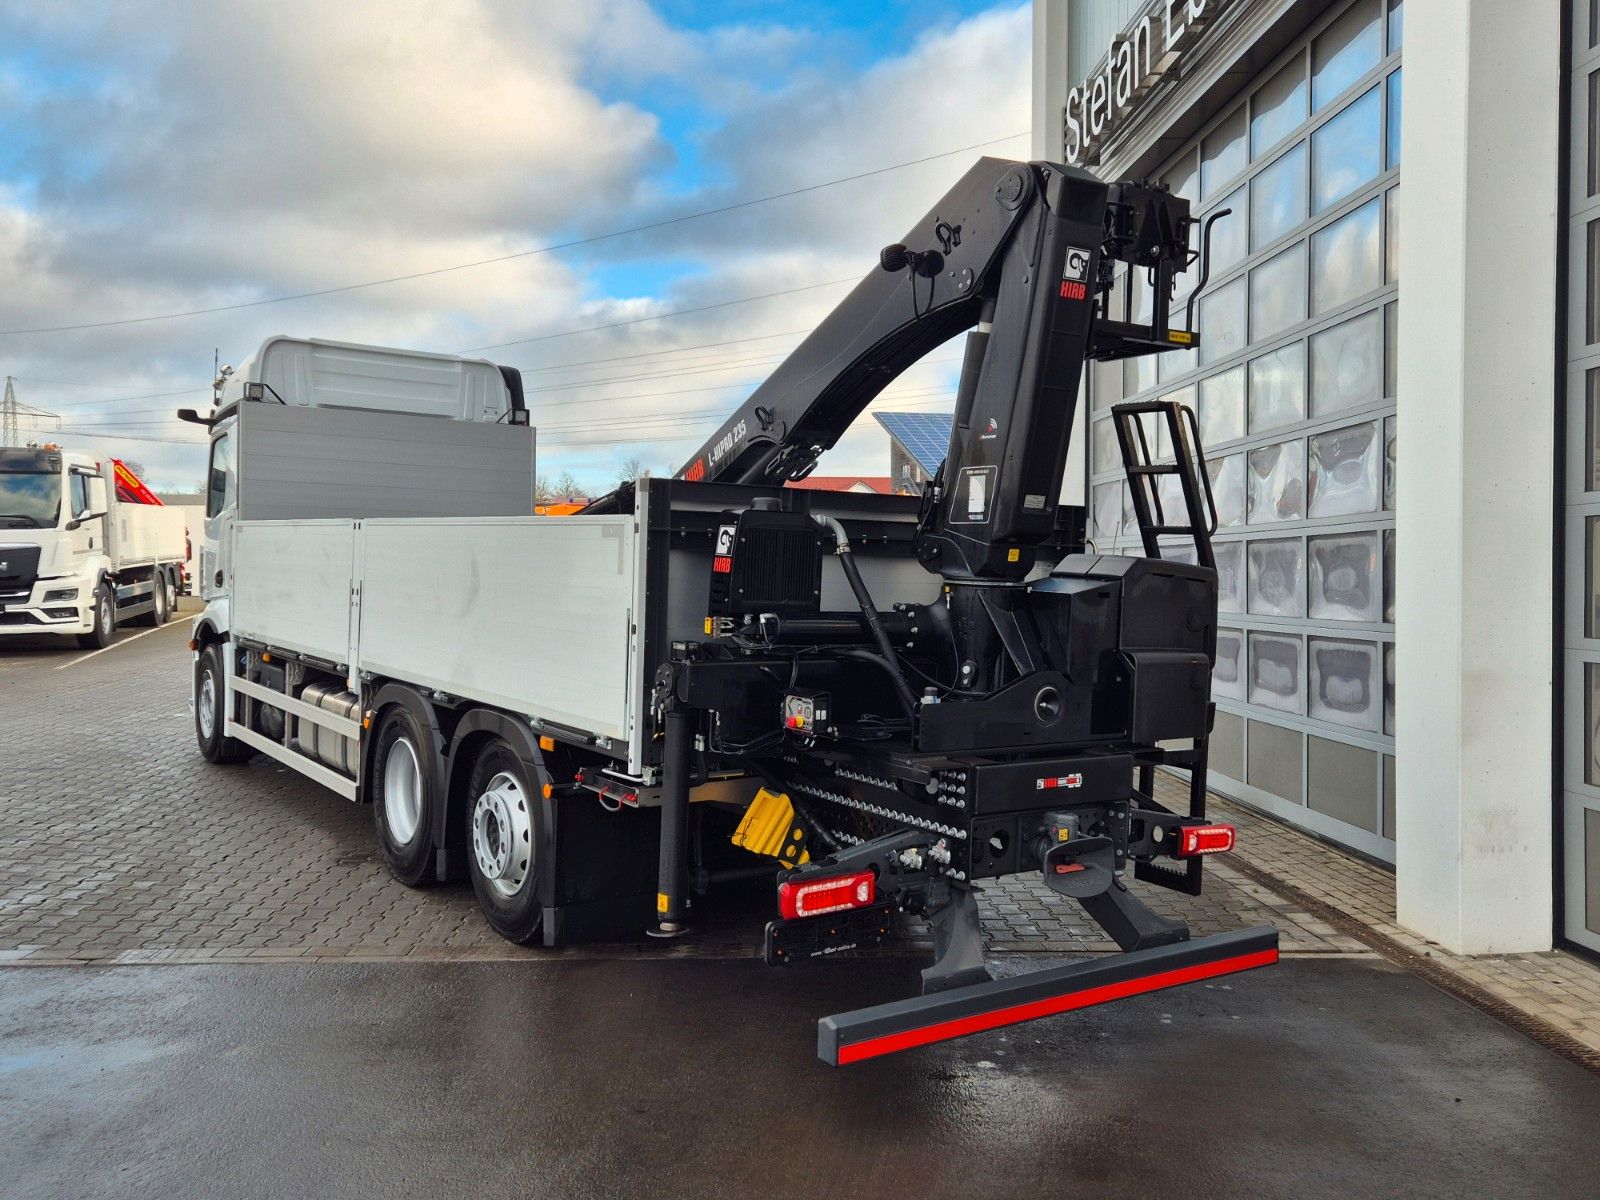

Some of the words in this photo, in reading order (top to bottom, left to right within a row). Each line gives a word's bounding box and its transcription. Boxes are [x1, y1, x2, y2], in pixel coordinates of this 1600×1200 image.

[1066, 15, 1150, 164] Stefan
[1060, 281, 1086, 300] HIAB
[708, 432, 733, 467] L-HIPRO
[733, 419, 747, 443] 235
[713, 556, 731, 573] HIAB
